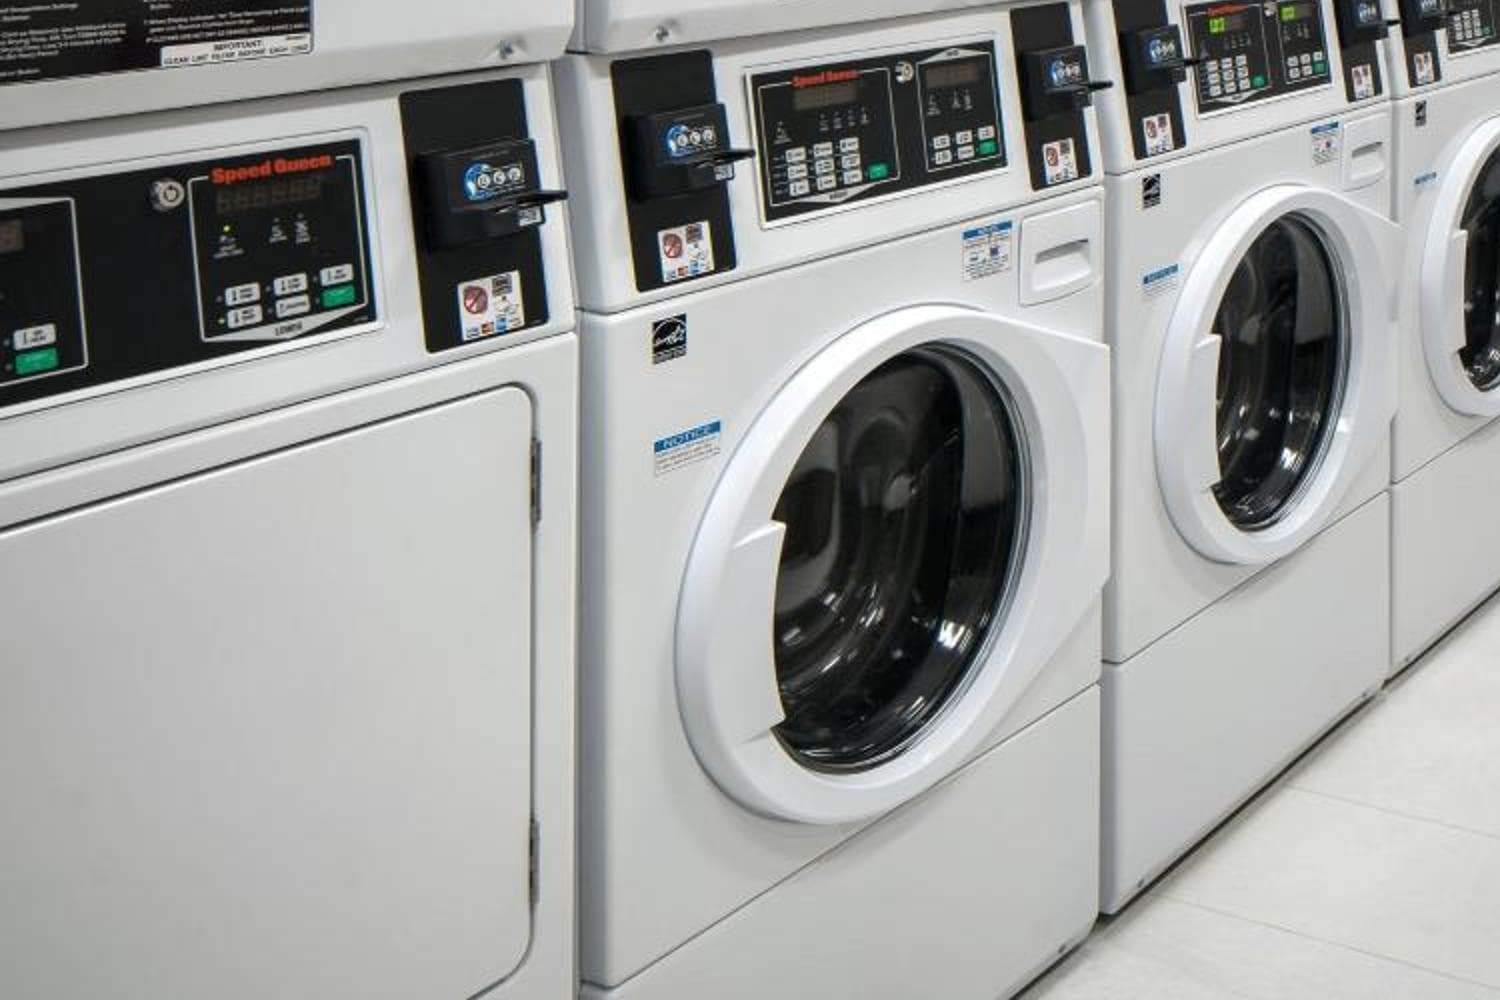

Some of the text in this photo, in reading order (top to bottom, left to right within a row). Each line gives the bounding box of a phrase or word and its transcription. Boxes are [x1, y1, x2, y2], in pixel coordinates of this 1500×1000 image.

[211, 155, 332, 185] Speed Queen
[663, 424, 711, 448] NOTICE
